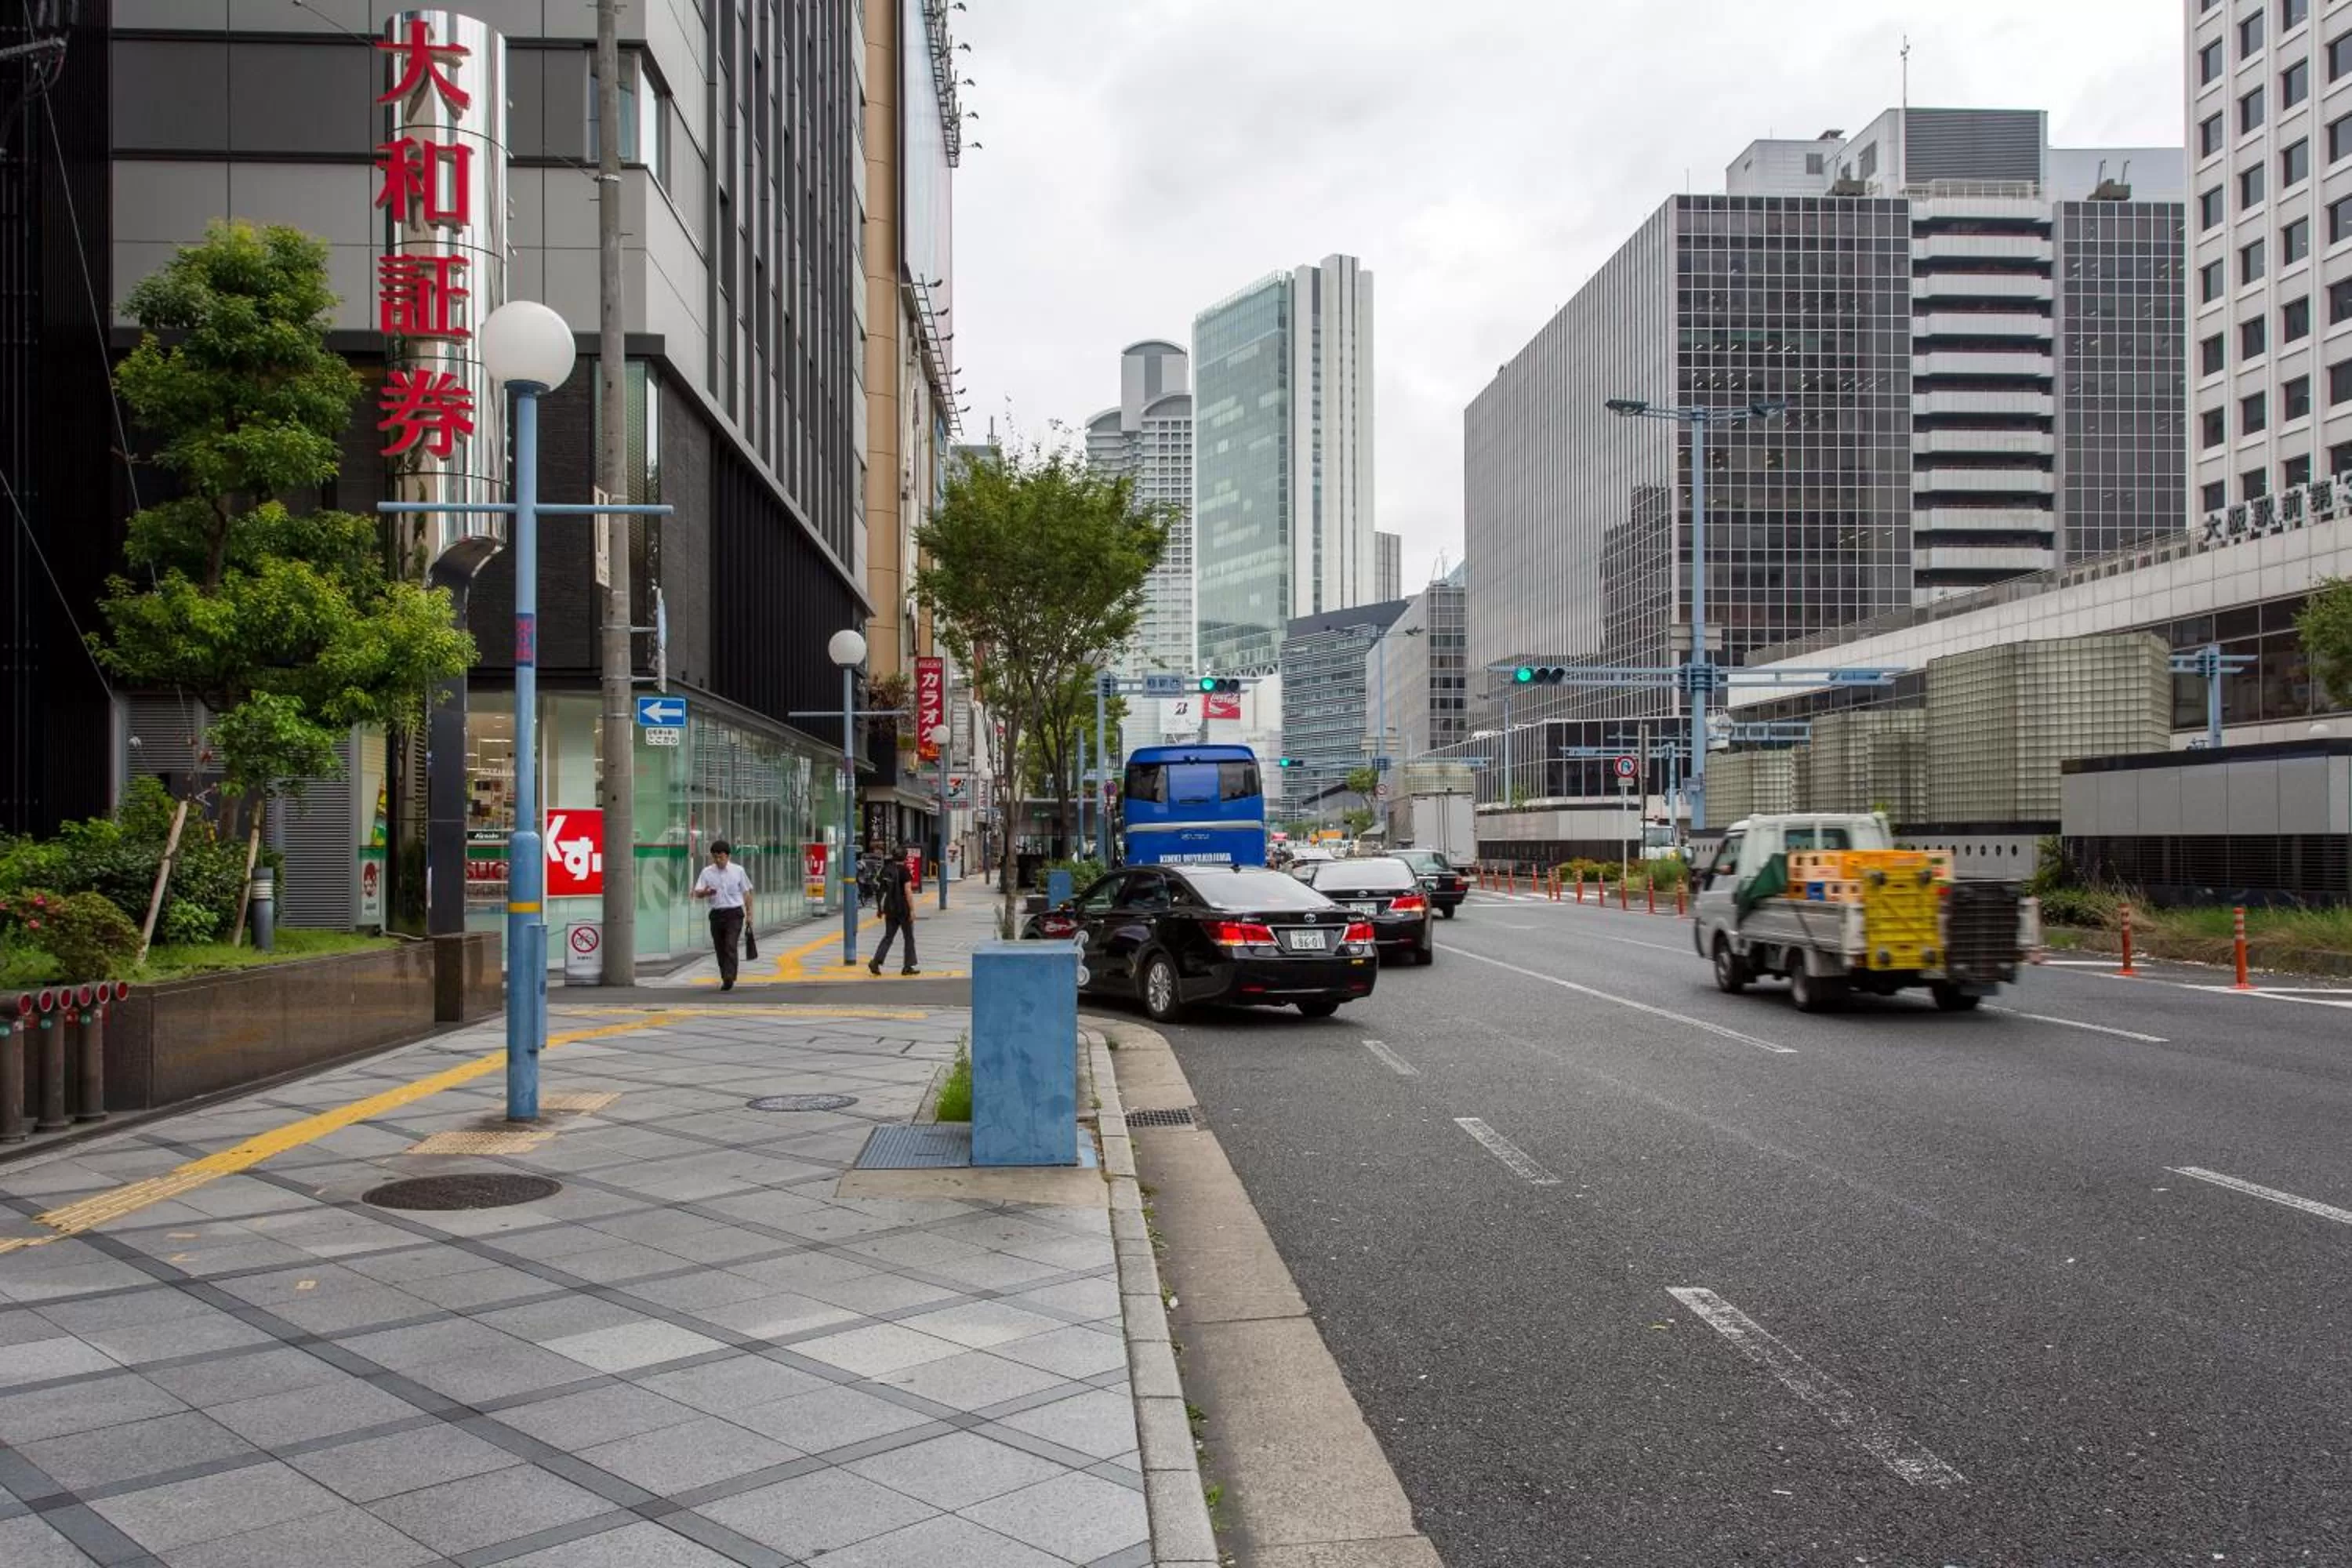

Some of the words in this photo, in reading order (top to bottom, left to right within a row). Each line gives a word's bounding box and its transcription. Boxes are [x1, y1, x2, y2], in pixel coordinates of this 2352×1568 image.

[376, 19, 475, 458] 大和証券
[547, 815, 602, 880] くす
